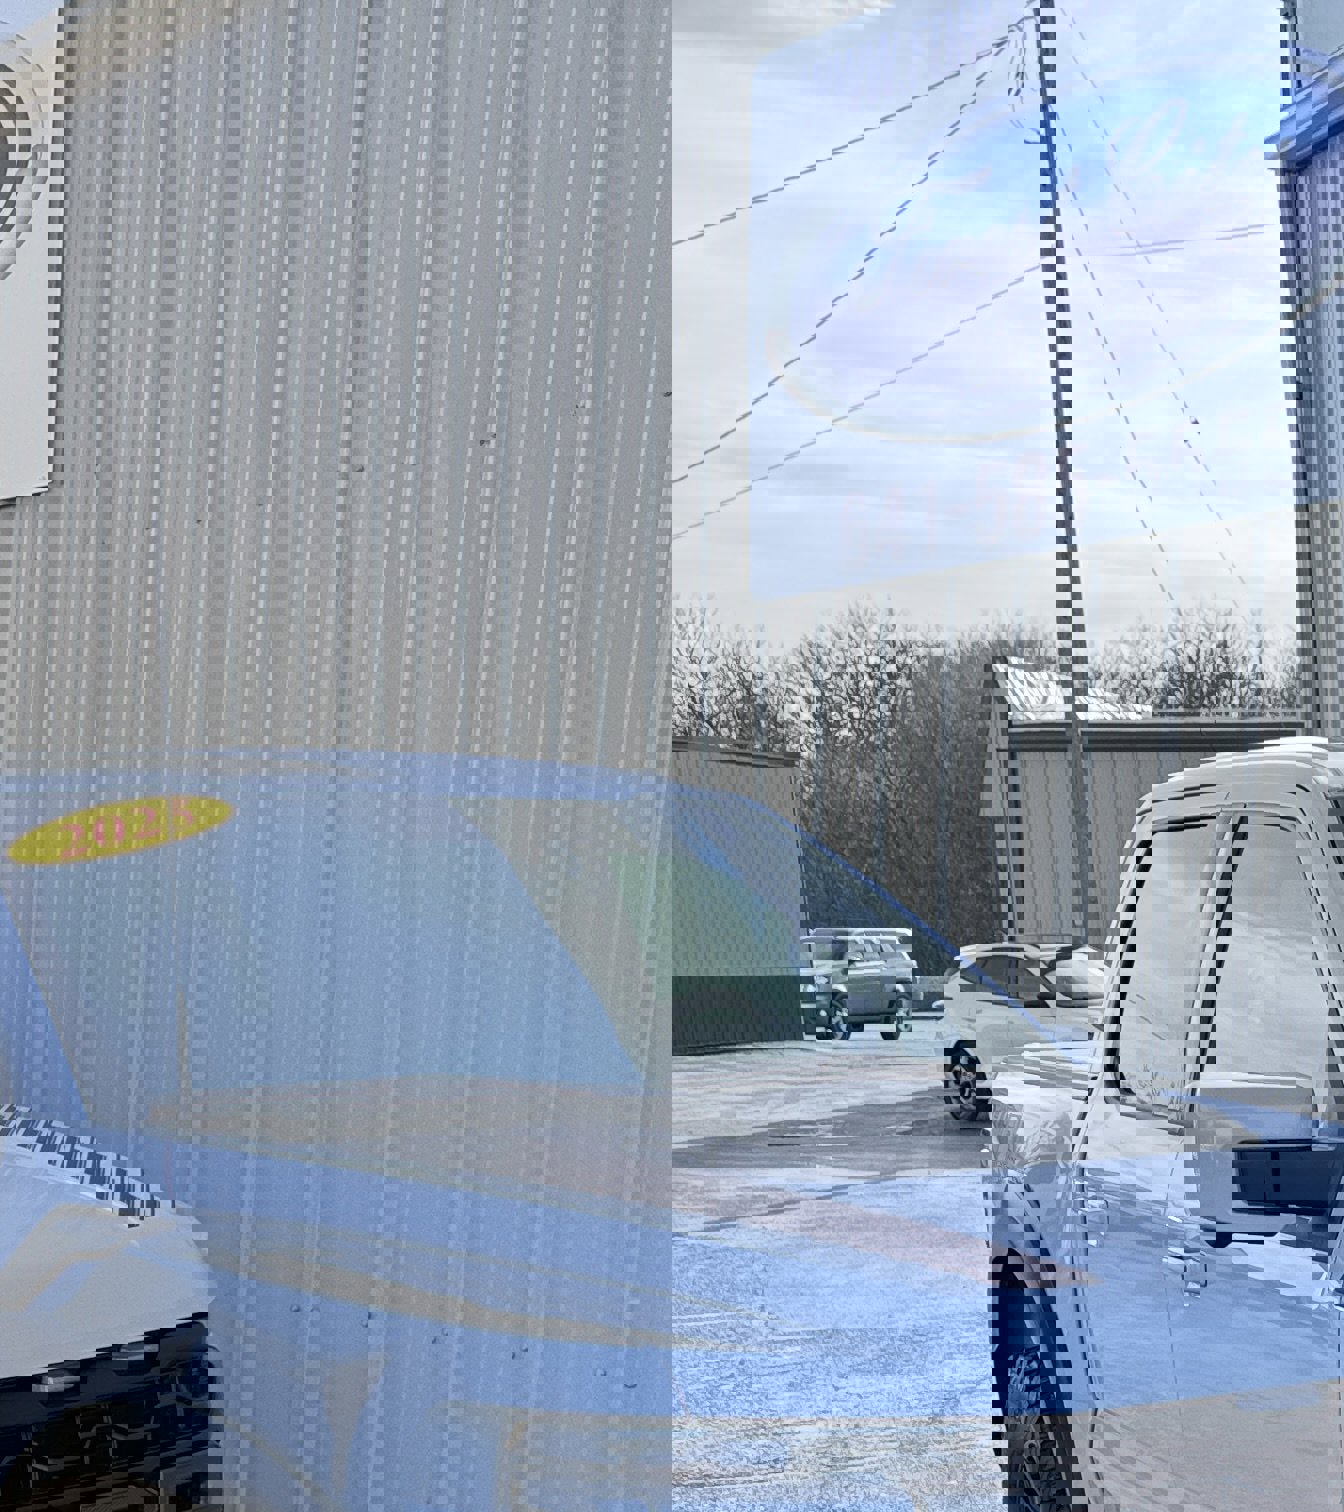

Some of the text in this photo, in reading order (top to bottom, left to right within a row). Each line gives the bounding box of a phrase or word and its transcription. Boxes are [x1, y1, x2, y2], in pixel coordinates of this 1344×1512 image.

[850, 96, 1296, 310] Forest City
[966, 265, 1136, 387] Ford
[840, 395, 1304, 574] 641-585-5555
[55, 799, 195, 860] 2025
